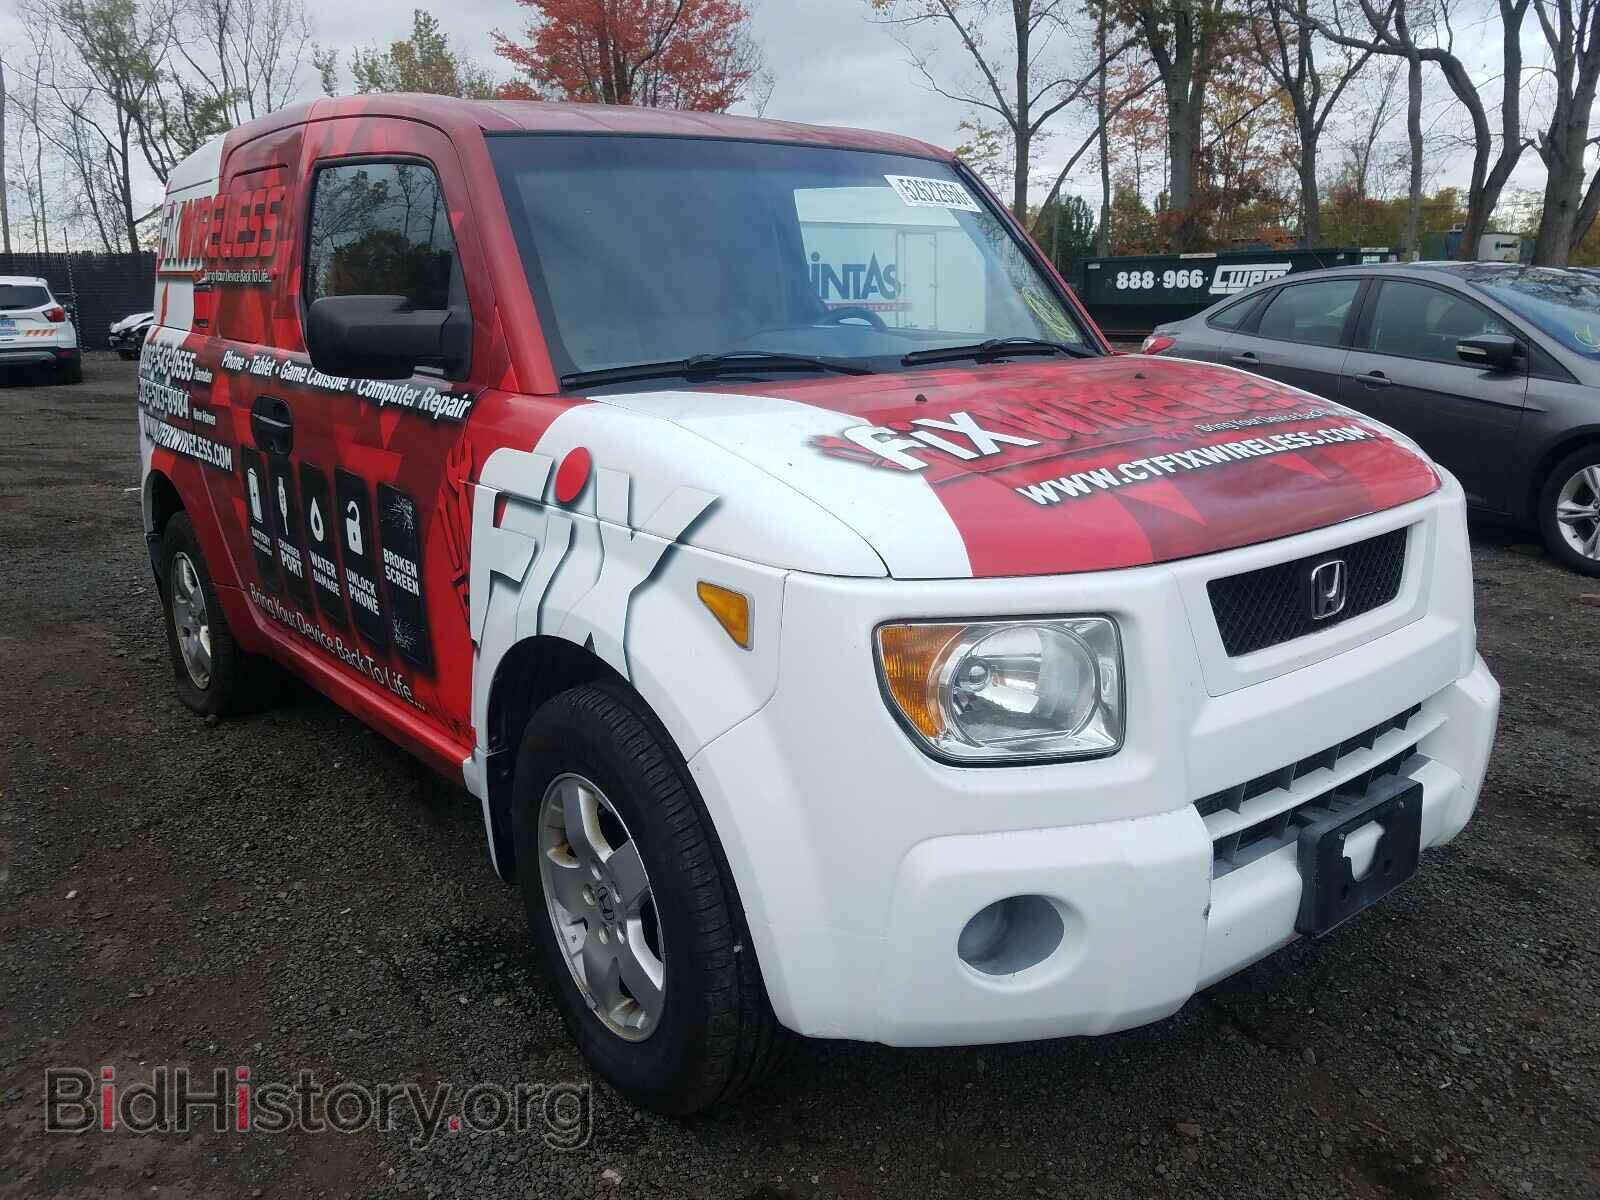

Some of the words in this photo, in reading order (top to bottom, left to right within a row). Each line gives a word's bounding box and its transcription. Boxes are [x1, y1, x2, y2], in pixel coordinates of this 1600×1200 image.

[807, 250, 902, 300] iNTAS
[221, 350, 245, 371] Phone
[250, 354, 275, 377] Tablet
[280, 362, 307, 383] Game
[307, 367, 348, 392] Console
[357, 378, 421, 407] Computer
[419, 386, 472, 420] Repair
[1015, 424, 1376, 506] WWW.CTFIXWIRELESS.COM
[280, 549, 304, 579] PORT
[309, 551, 337, 579] WATER
[383, 548, 418, 578] BROKEN
[313, 569, 341, 597] DAMAGE
[345, 567, 377, 598] UNLOCK
[385, 566, 420, 596] SCREEN
[348, 584, 380, 616] PHONE
[250, 582, 274, 615] Bring
[271, 597, 297, 627] Your
[296, 611, 335, 653] Device
[335, 636, 368, 674] Back
[366, 655, 385, 685] To
